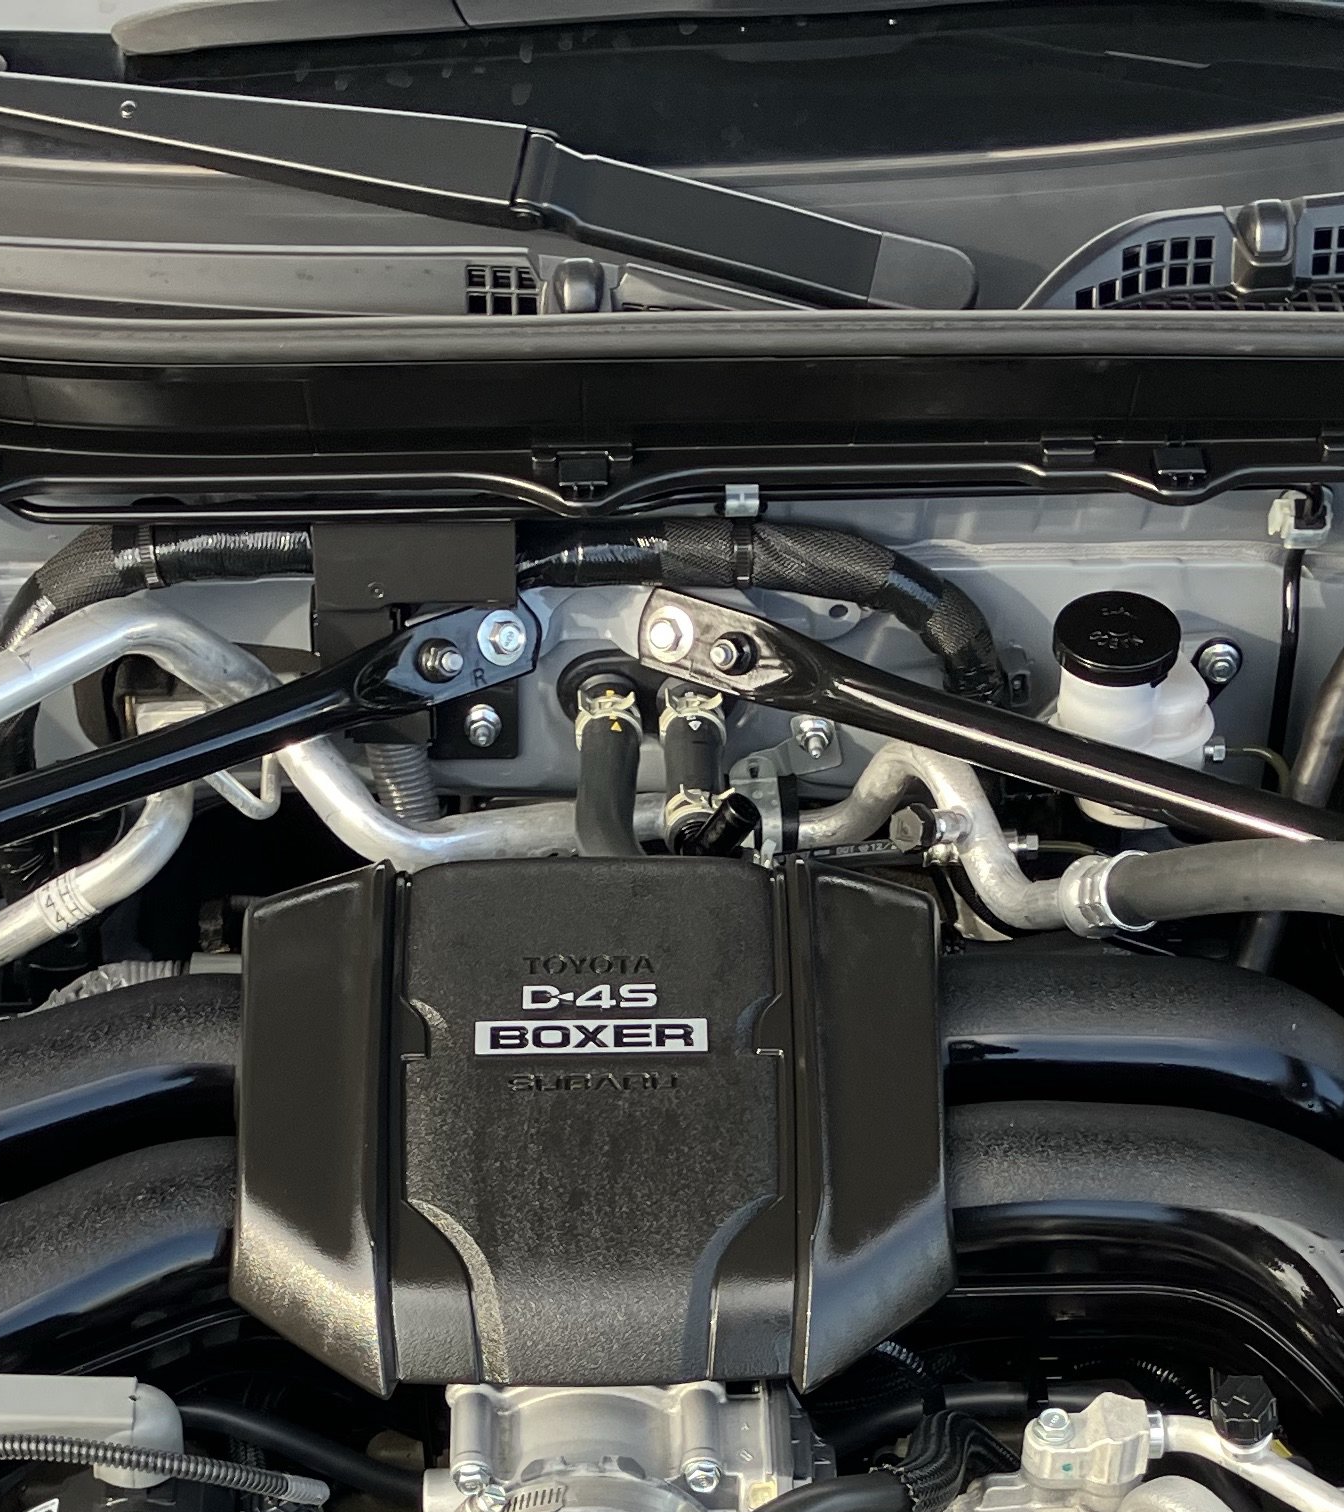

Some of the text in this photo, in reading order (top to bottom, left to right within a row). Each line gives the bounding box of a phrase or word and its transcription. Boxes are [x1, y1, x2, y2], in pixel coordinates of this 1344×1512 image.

[523, 956, 655, 975] TOYOTA
[522, 983, 658, 1011] D-4S
[489, 1023, 694, 1050] BOXER
[507, 1072, 680, 1092] SUBARU
